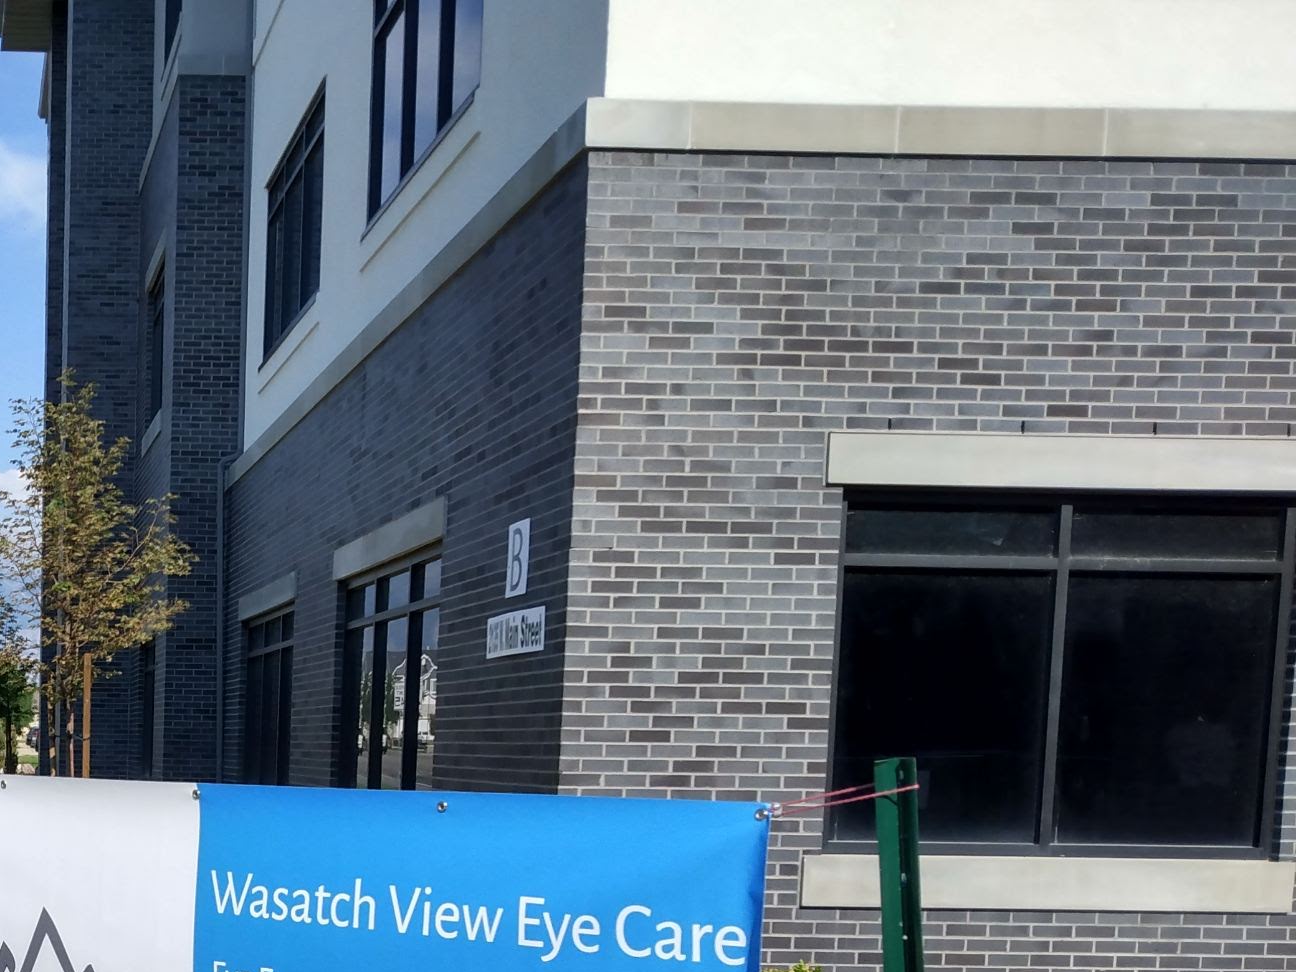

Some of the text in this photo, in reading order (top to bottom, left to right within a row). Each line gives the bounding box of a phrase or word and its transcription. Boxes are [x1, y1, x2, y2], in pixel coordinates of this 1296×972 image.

[509, 527, 524, 592] B
[520, 613, 542, 648] Street
[211, 869, 747, 966] Wasatch View Eye Care
